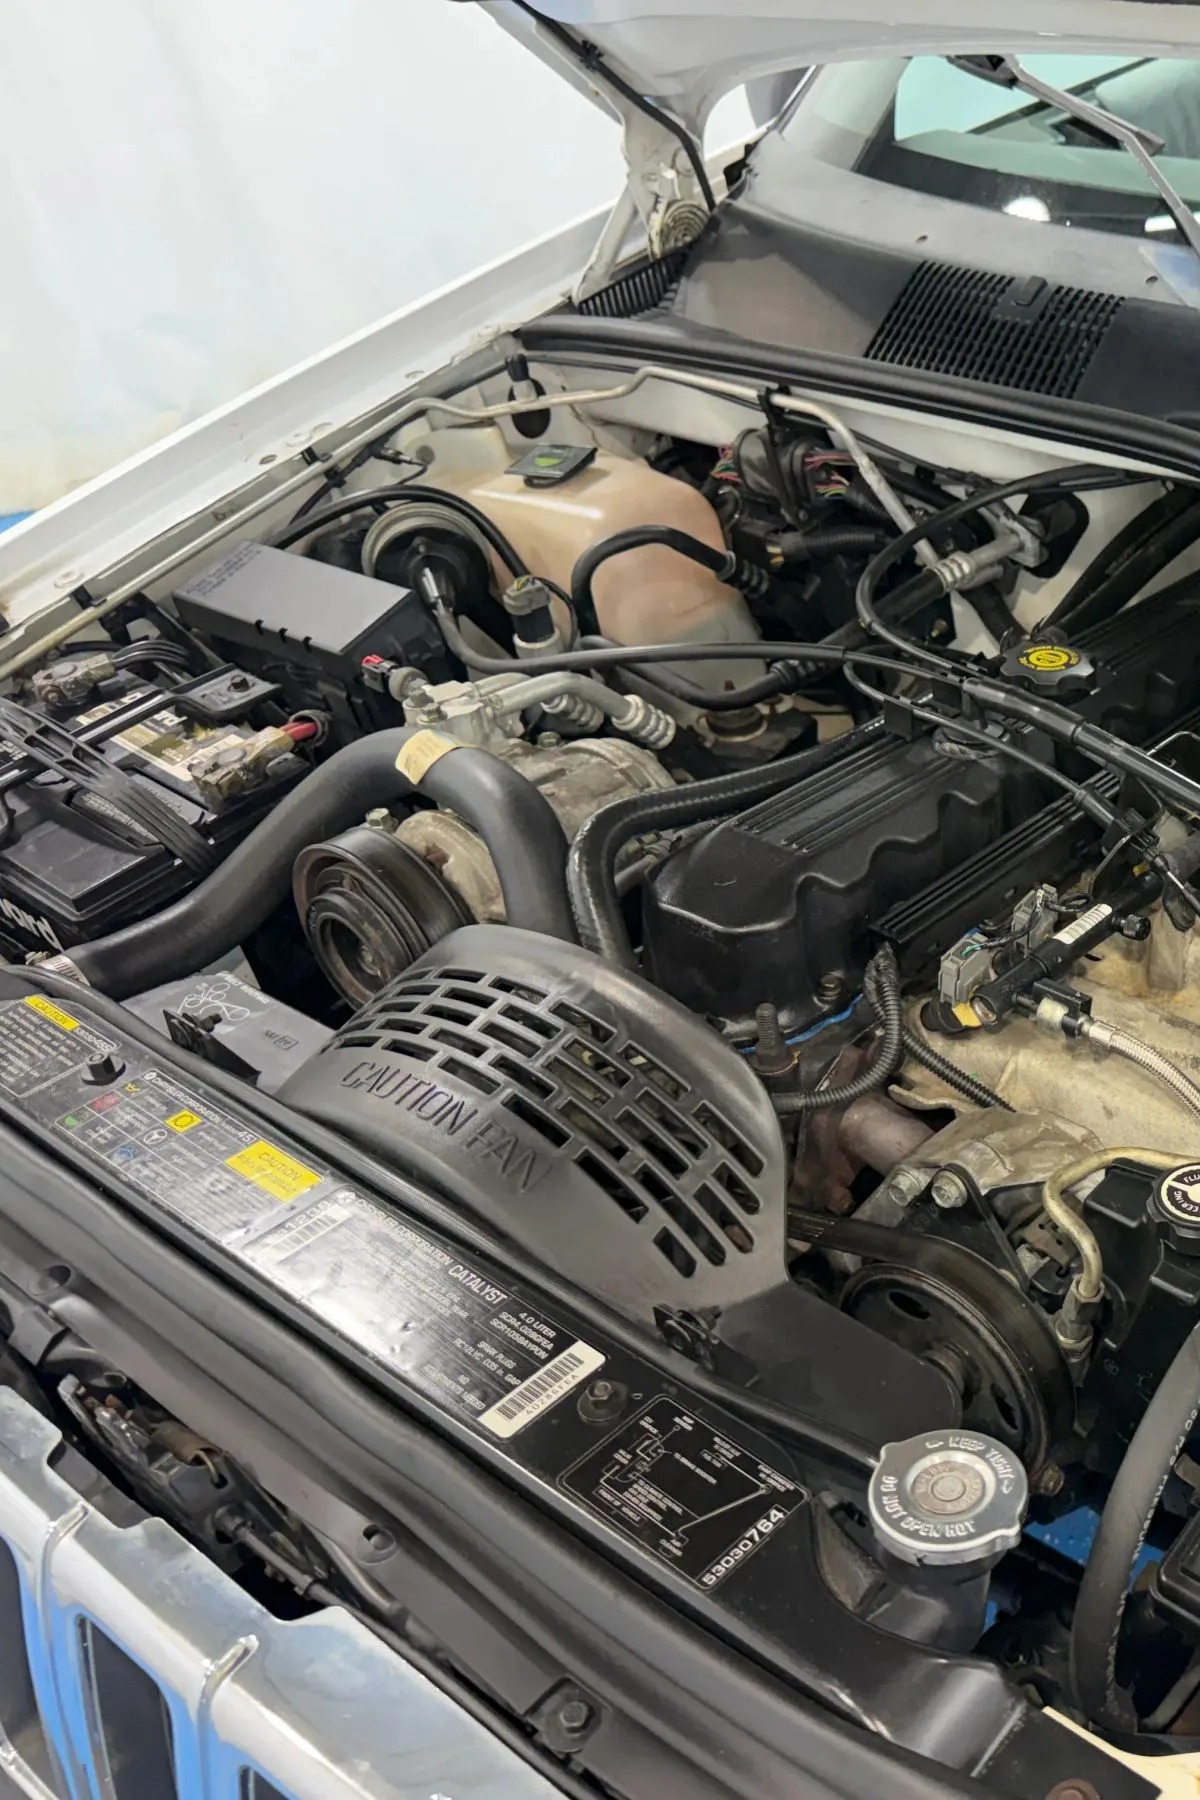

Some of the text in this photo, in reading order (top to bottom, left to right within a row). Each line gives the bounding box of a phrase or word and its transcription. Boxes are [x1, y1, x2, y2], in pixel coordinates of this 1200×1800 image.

[340, 1061, 553, 1194] CAUTION FAN
[258, 1151, 303, 1181] CAUTION
[356, 1199, 398, 1230] CHRYSLER
[398, 1225, 454, 1266] CORPORATION
[448, 1264, 509, 1305] CATALYST
[518, 1312, 557, 1339] 4.0 LITER
[477, 1341, 517, 1369] SPARK PLUGS
[949, 1436, 1016, 1479] KEEP TIGHT
[880, 1475, 899, 1492] DO
[882, 1495, 908, 1519] NOT
[900, 1517, 943, 1538] OPEN
[945, 1521, 977, 1538] HOT
[702, 1508, 786, 1586] 53030764
